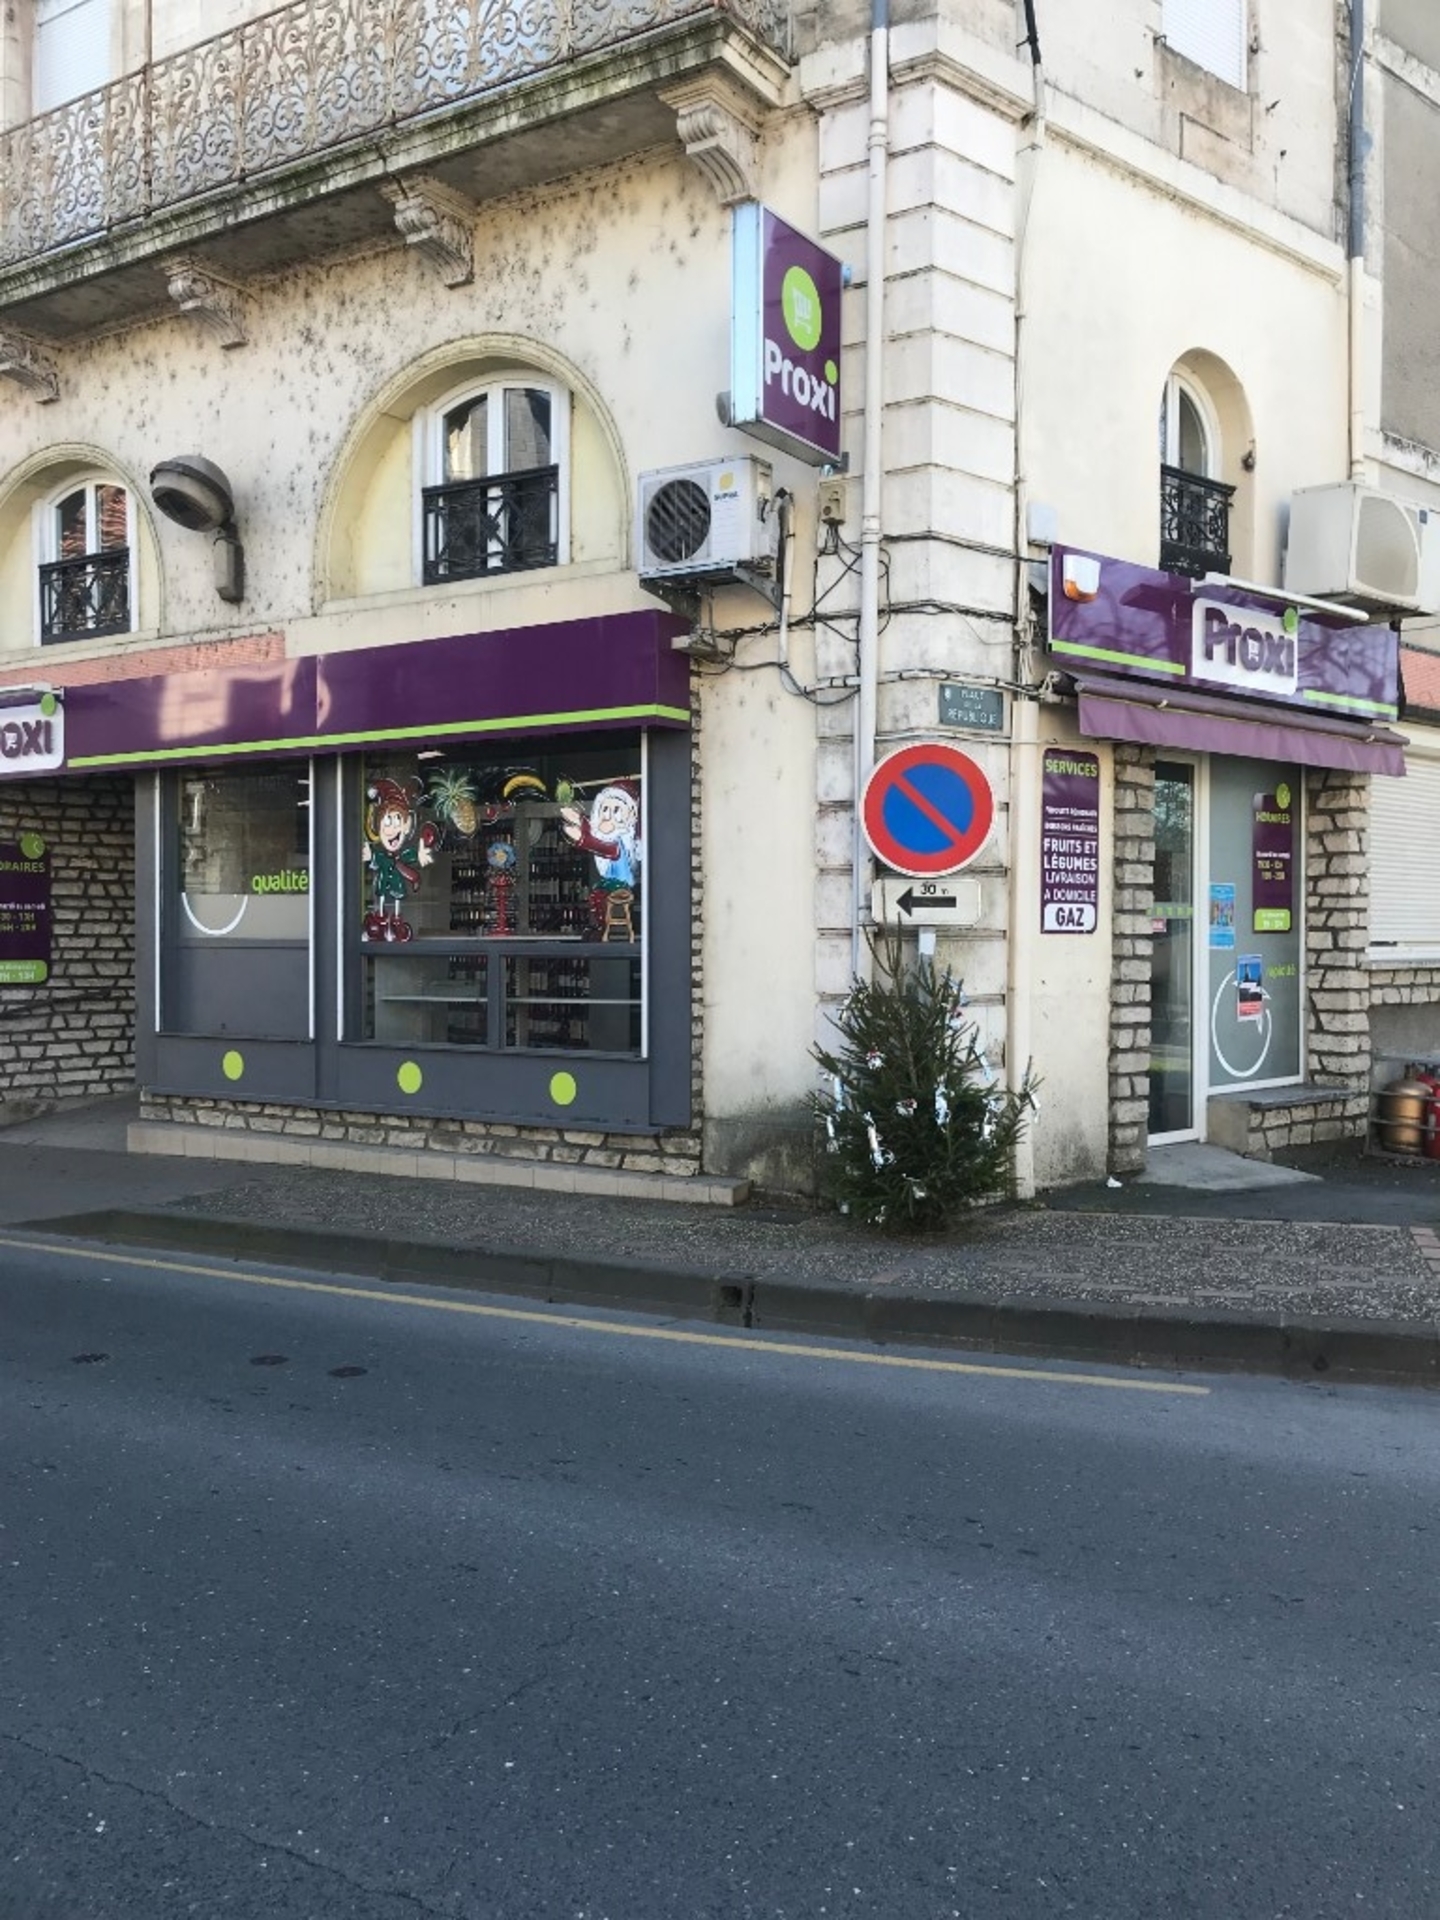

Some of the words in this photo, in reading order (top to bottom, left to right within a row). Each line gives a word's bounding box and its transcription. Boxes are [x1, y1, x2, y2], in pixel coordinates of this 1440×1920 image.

[764, 337, 838, 422] Proxi
[1204, 606, 1298, 679] Proxi
[0, 693, 56, 758] oxi
[1045, 758, 1098, 778] SERVICES
[1043, 837, 1082, 854] FRUITS
[1084, 841, 1098, 854] ET
[1043, 852, 1098, 871] LÉGUMES
[252, 869, 309, 896] qualité
[1045, 871, 1096, 885] LIVRAISON
[920, 884, 937, 895] 30
[1055, 906, 1086, 927] GAZ
